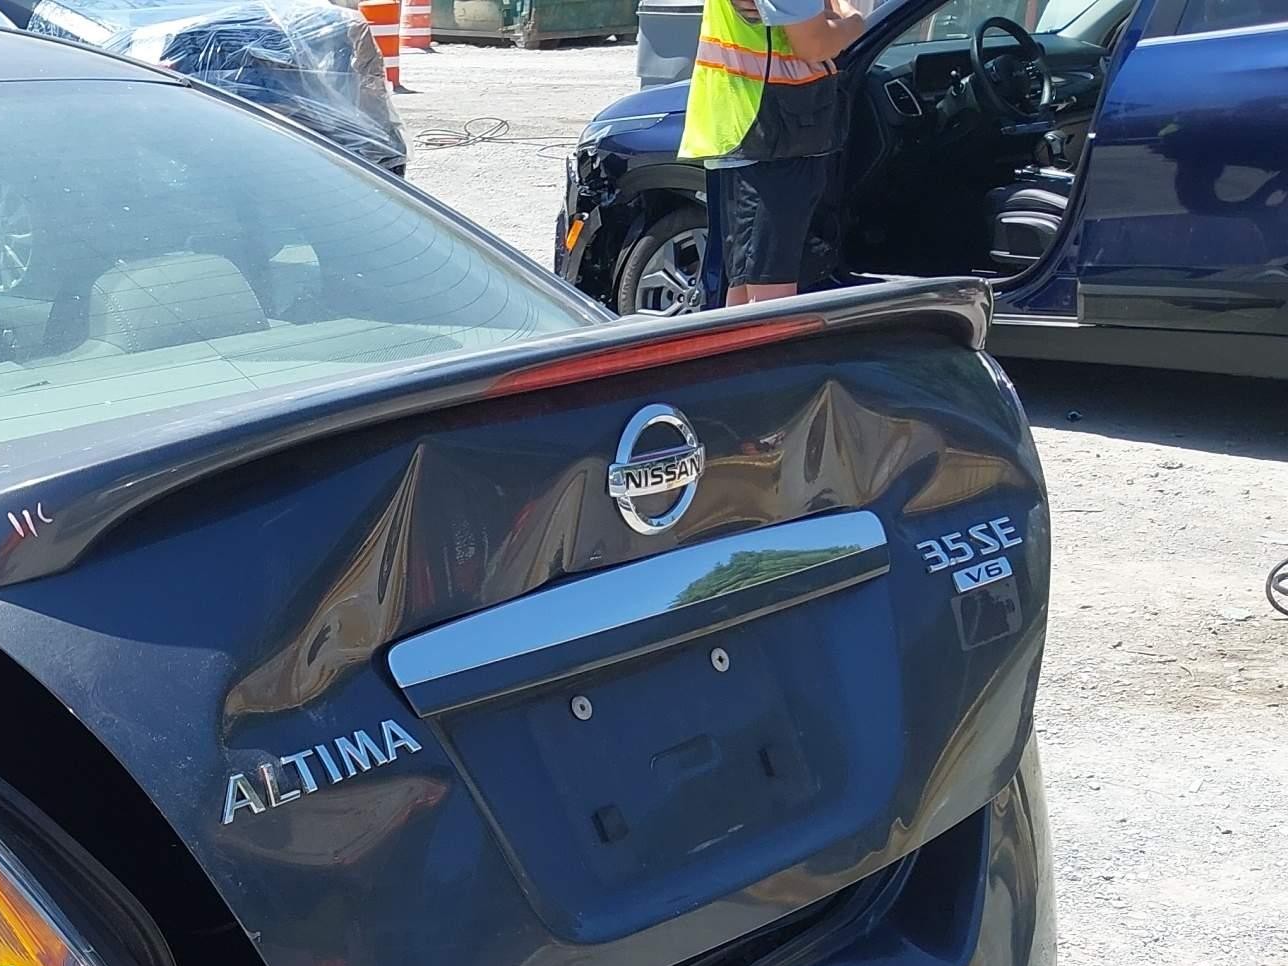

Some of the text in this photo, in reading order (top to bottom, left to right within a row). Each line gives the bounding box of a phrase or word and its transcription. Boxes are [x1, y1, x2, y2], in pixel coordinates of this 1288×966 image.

[624, 454, 701, 490] NISSAN
[964, 561, 1003, 584] V6
[220, 719, 423, 826] ALTIMA
